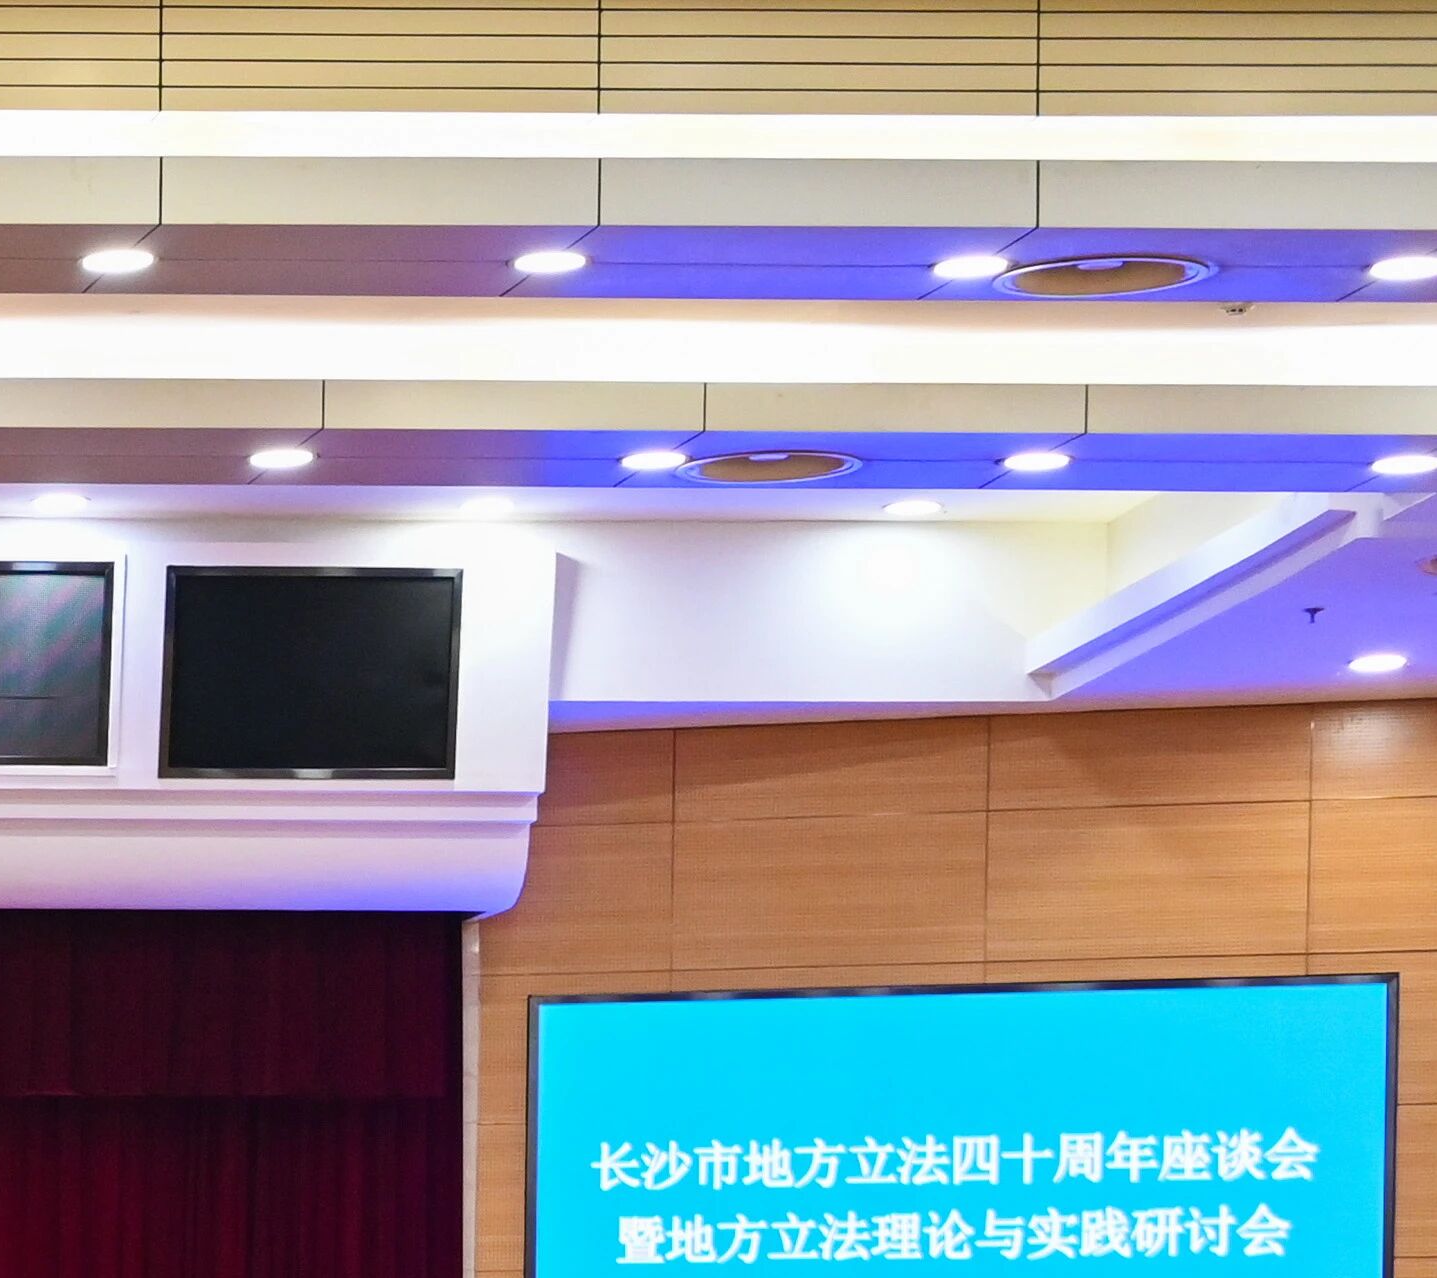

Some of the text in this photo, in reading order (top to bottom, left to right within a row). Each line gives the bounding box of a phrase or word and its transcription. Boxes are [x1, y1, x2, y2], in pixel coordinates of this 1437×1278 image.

[591, 1127, 1320, 1190] 长沙市地方立法四十周年座谈会
[616, 1204, 1292, 1265] 暨地方立法理论与实践研讨会
